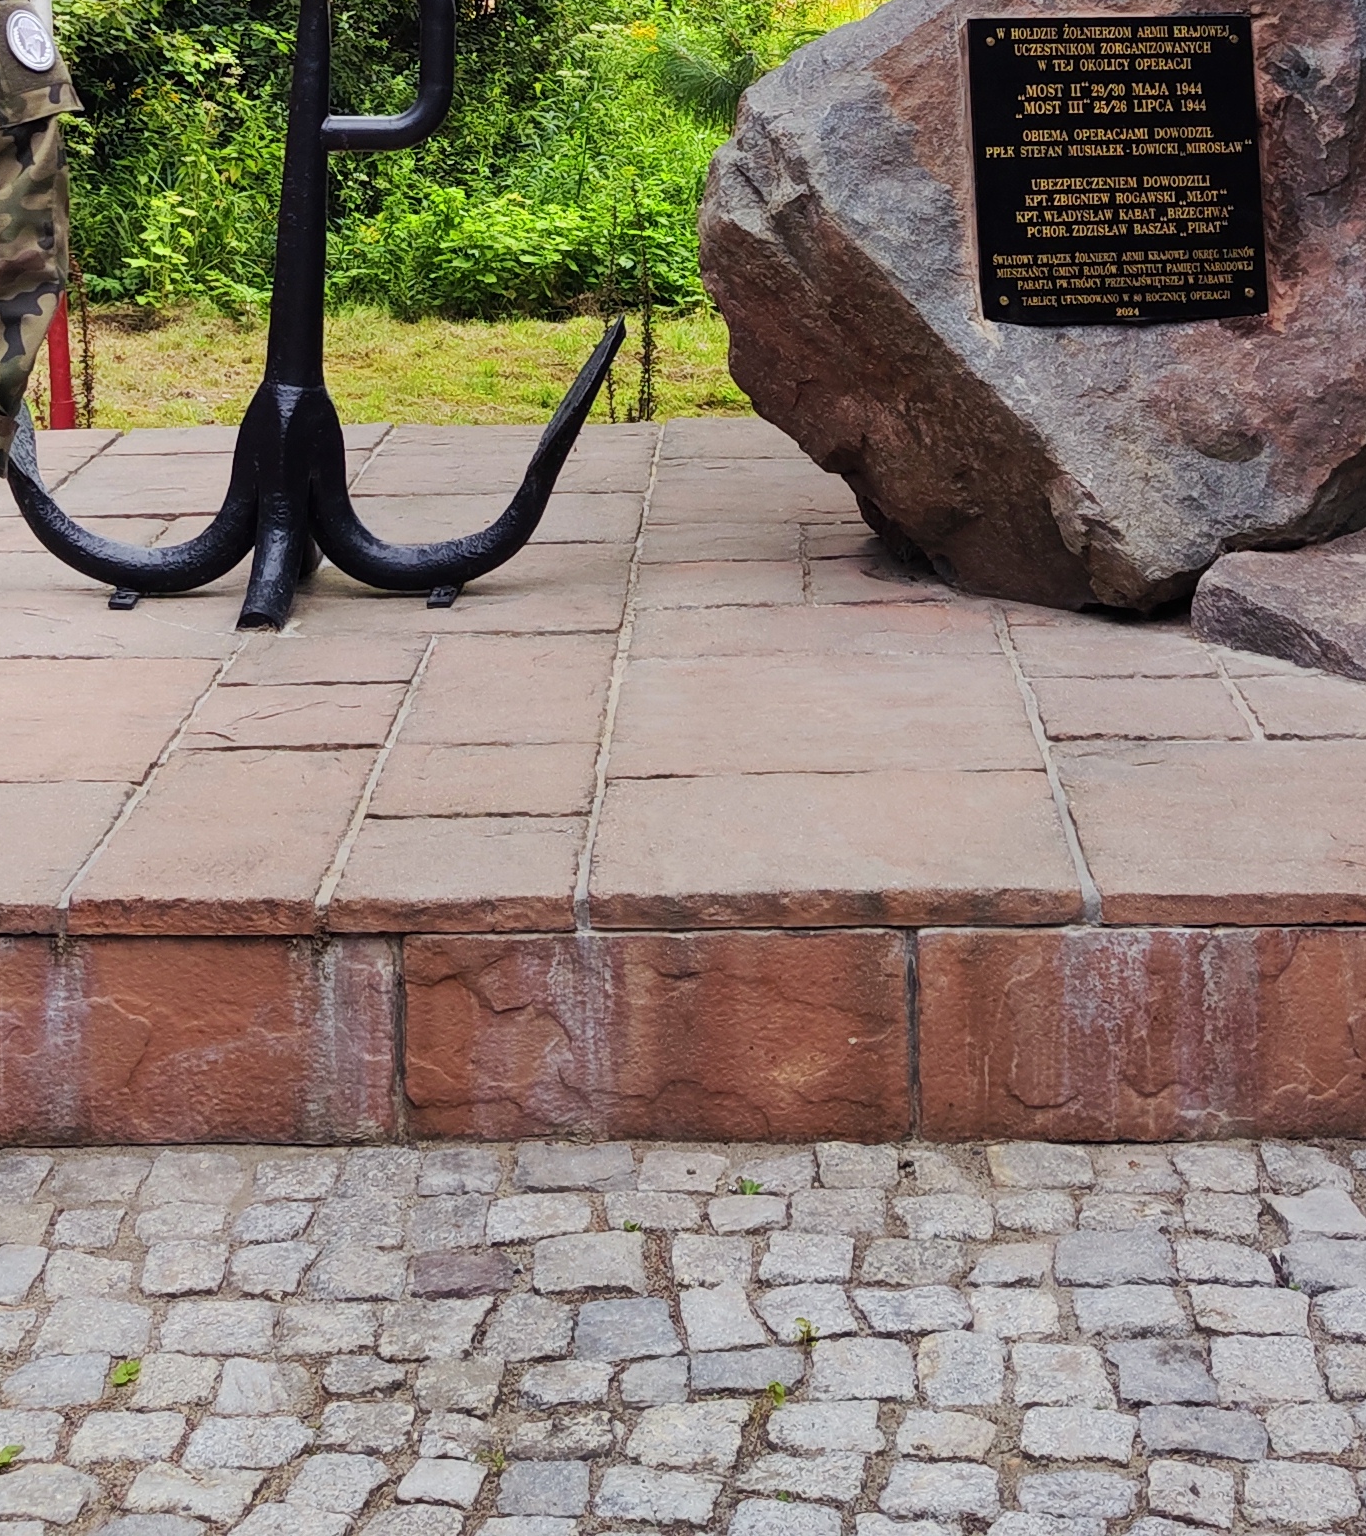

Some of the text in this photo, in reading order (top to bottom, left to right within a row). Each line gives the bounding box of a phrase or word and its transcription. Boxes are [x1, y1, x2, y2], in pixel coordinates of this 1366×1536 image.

[996, 23, 1229, 40] W HOŁDZIE ŻOŁNIERZOM ARMII KRAJOWEJ
[1014, 41, 1212, 56] UCZESTNIKOM ZORGANIZOWANYCH
[1037, 57, 1192, 71] W TEJ OKOLICY OPERACJI
[1091, 83, 1126, 98] 29/30
[1132, 82, 1169, 96] MAJA
[1176, 82, 1202, 95] 1944
[1093, 100, 1127, 114] 25/26
[1133, 98, 1174, 113] LIPCA
[1181, 98, 1207, 112] 1944
[1022, 126, 1214, 142] OBIEMA OPERACJAMI DOWODZIŁ
[985, 146, 1015, 158] PPŁK
[1020, 145, 1062, 158] STEFAN
[1031, 174, 1210, 190] UBEZPIECZENIEM DOWODZILI
[1025, 195, 1051, 206] KPT.
[1053, 193, 1110, 206] ZBIGNIEW
[1115, 191, 1175, 204] ROGAWSKI
[1016, 211, 1041, 223] KPT.
[1044, 209, 1113, 222] WŁADYSŁAW
[1119, 208, 1156, 221] KABAT
[1027, 226, 1070, 238] PCHOR.
[1072, 224, 1128, 237] ZDZISŁAW
[1133, 222, 1177, 235] BASZAK
[992, 253, 1034, 266] ŚWIATOWY
[1037, 253, 1072, 265] ZWIĄZEK
[1121, 251, 1144, 262] ARMII
[1148, 249, 1189, 261] KRAJOWEJ
[1192, 248, 1220, 261] OKRĘG
[1223, 246, 1255, 259] TARNÓW
[996, 266, 1049, 279] MIESZKAŃCY
[1053, 266, 1080, 277] GMINY
[1123, 263, 1163, 275] INSTYTUT
[1166, 262, 1200, 275] PAMIĘCI
[1204, 260, 1254, 272] NARODOWEJ
[1017, 279, 1053, 291] PARAFIA
[1187, 275, 1195, 284] W
[1198, 273, 1234, 284] ZABAWIE
[1021, 295, 1058, 307] TABLICĘ
[1060, 293, 1120, 305] UFUNDOWANO
[1122, 292, 1131, 303] W
[1145, 291, 1187, 303] ROCZNICĘ
[1190, 290, 1231, 301] OPERACJI
[1116, 306, 1140, 317] 2024
